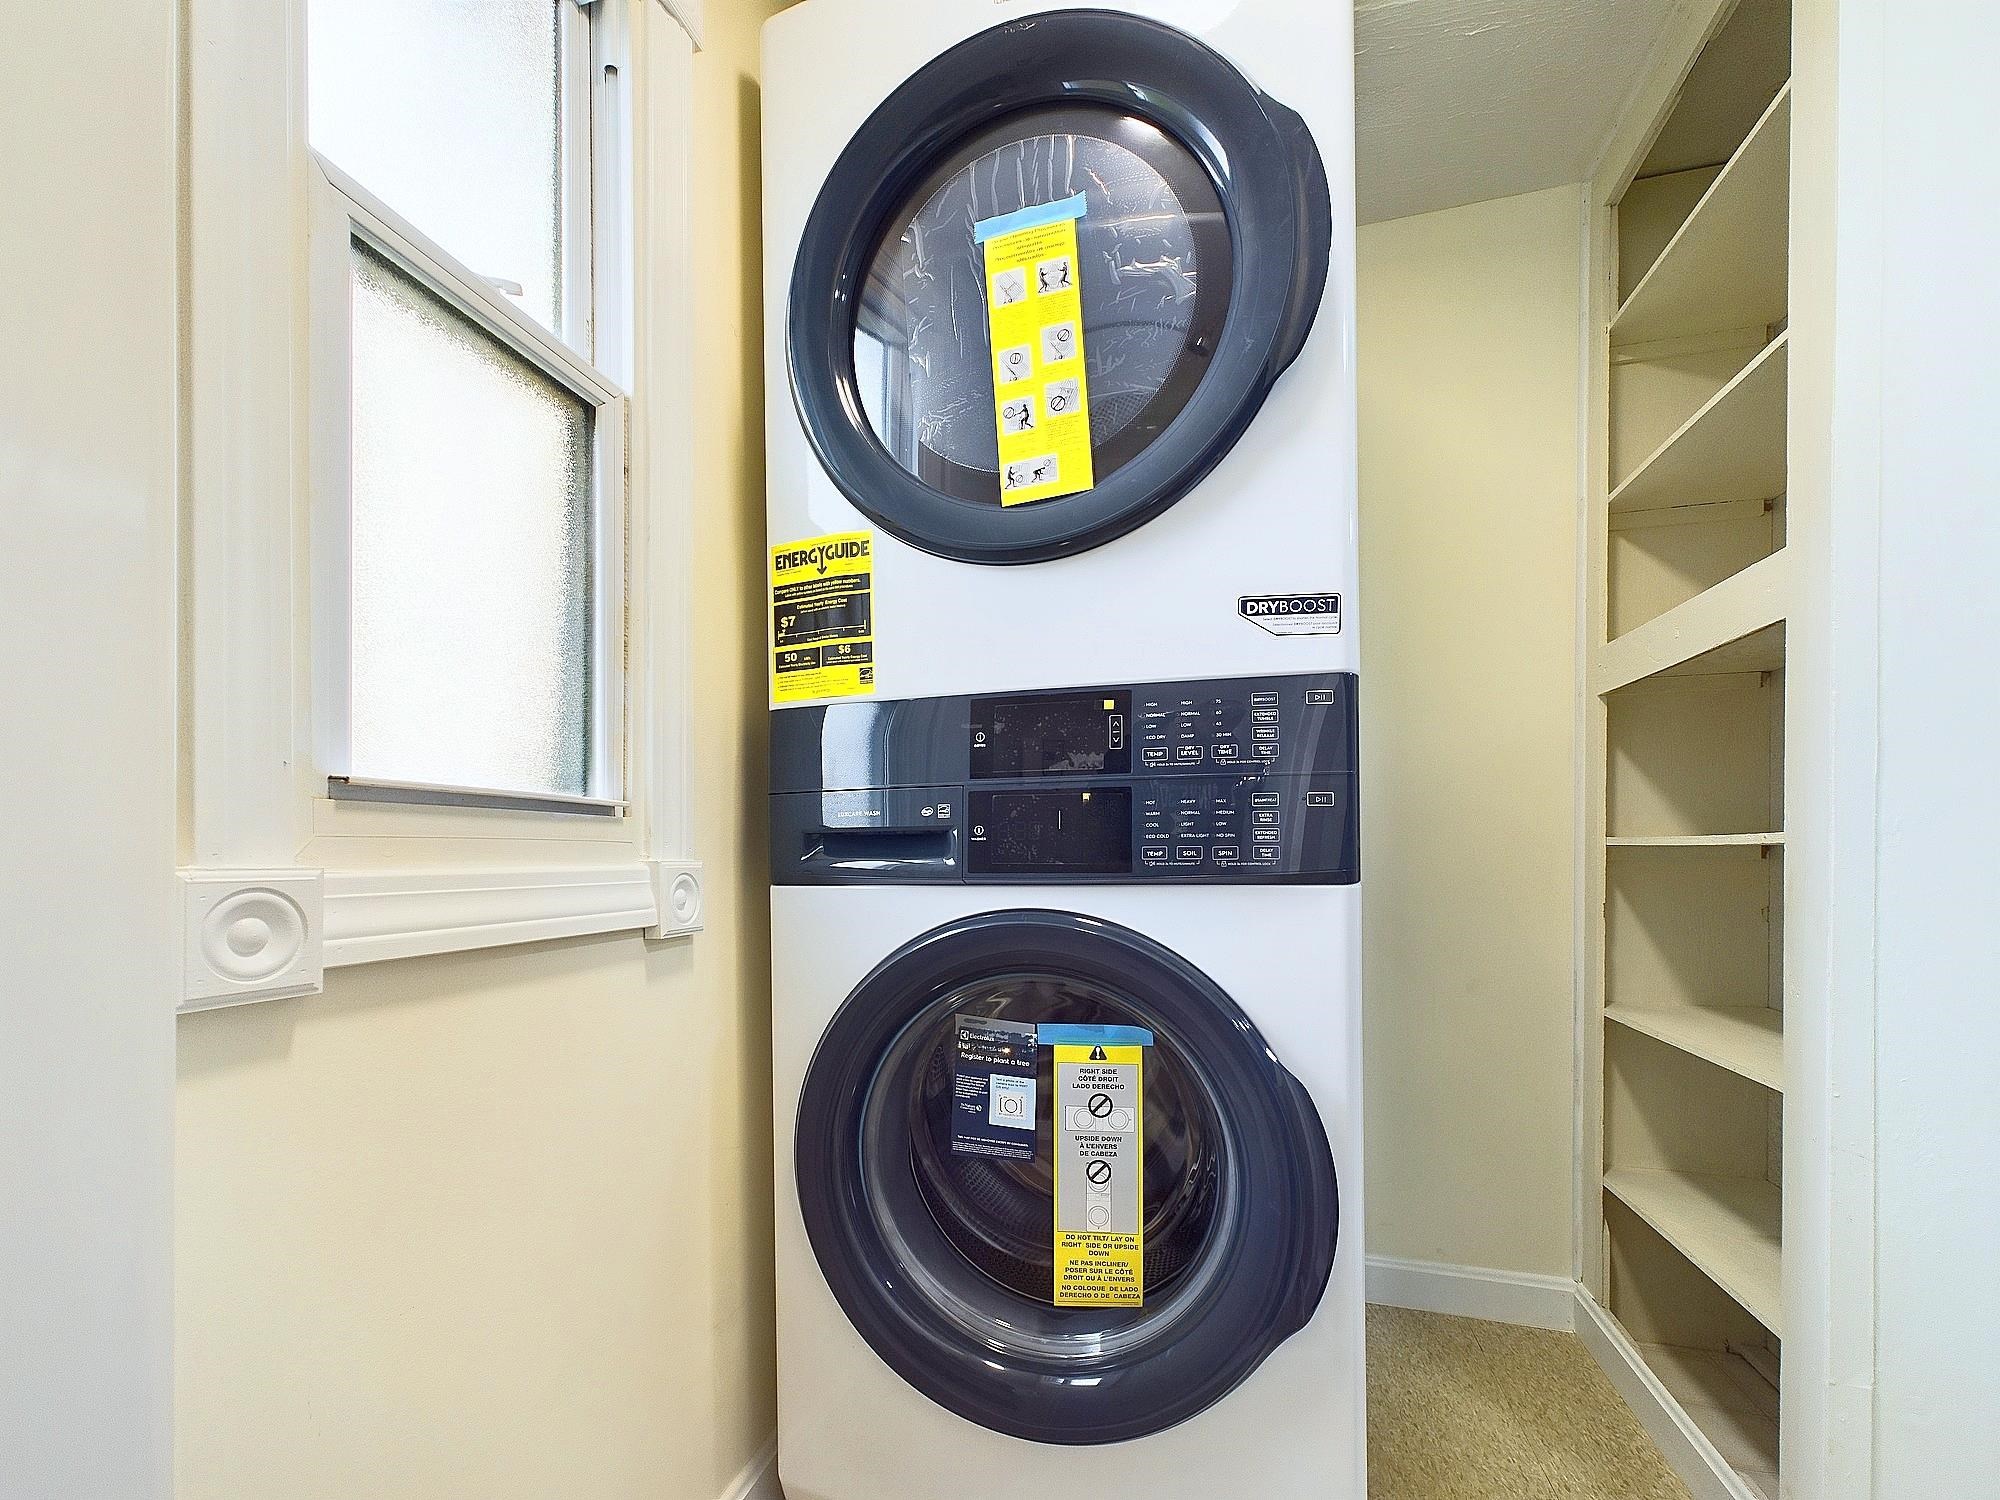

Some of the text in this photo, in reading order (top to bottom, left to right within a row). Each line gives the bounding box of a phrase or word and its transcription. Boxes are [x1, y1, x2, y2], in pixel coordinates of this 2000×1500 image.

[775, 540, 870, 573] ENERGYGUIDE
[1246, 598, 1336, 614] DRYBOOST
[781, 615, 796, 628] $7
[838, 645, 852, 654] $6
[784, 652, 797, 662] 50
[970, 1033, 994, 1042] Electrolux
[960, 1052, 984, 1060] Register
